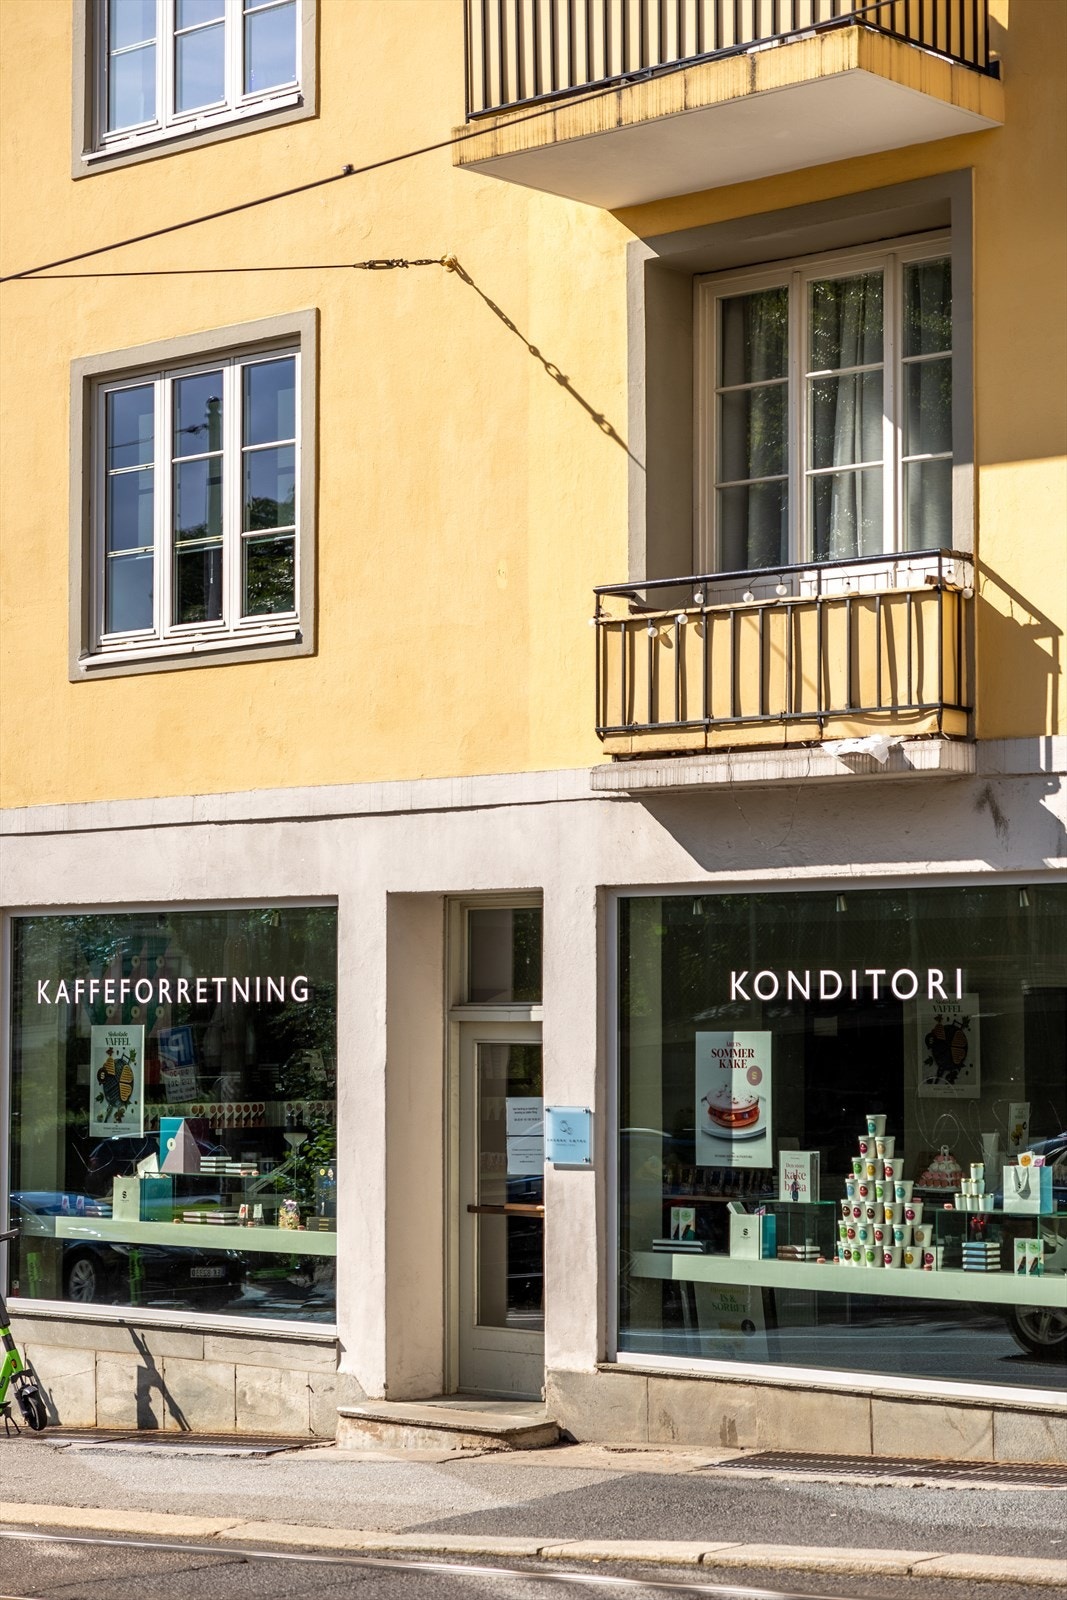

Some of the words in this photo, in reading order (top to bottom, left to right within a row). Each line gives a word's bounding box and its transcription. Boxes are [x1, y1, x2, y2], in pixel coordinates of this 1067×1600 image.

[37, 975, 310, 1005] KAFFEFORRETNING
[731, 968, 963, 1001] KONDITORI
[105, 1037, 131, 1046] VAFFEL
[711, 1048, 755, 1059] SOMMER
[718, 1058, 748, 1069] KAKE
[784, 1168, 807, 1181] kake
